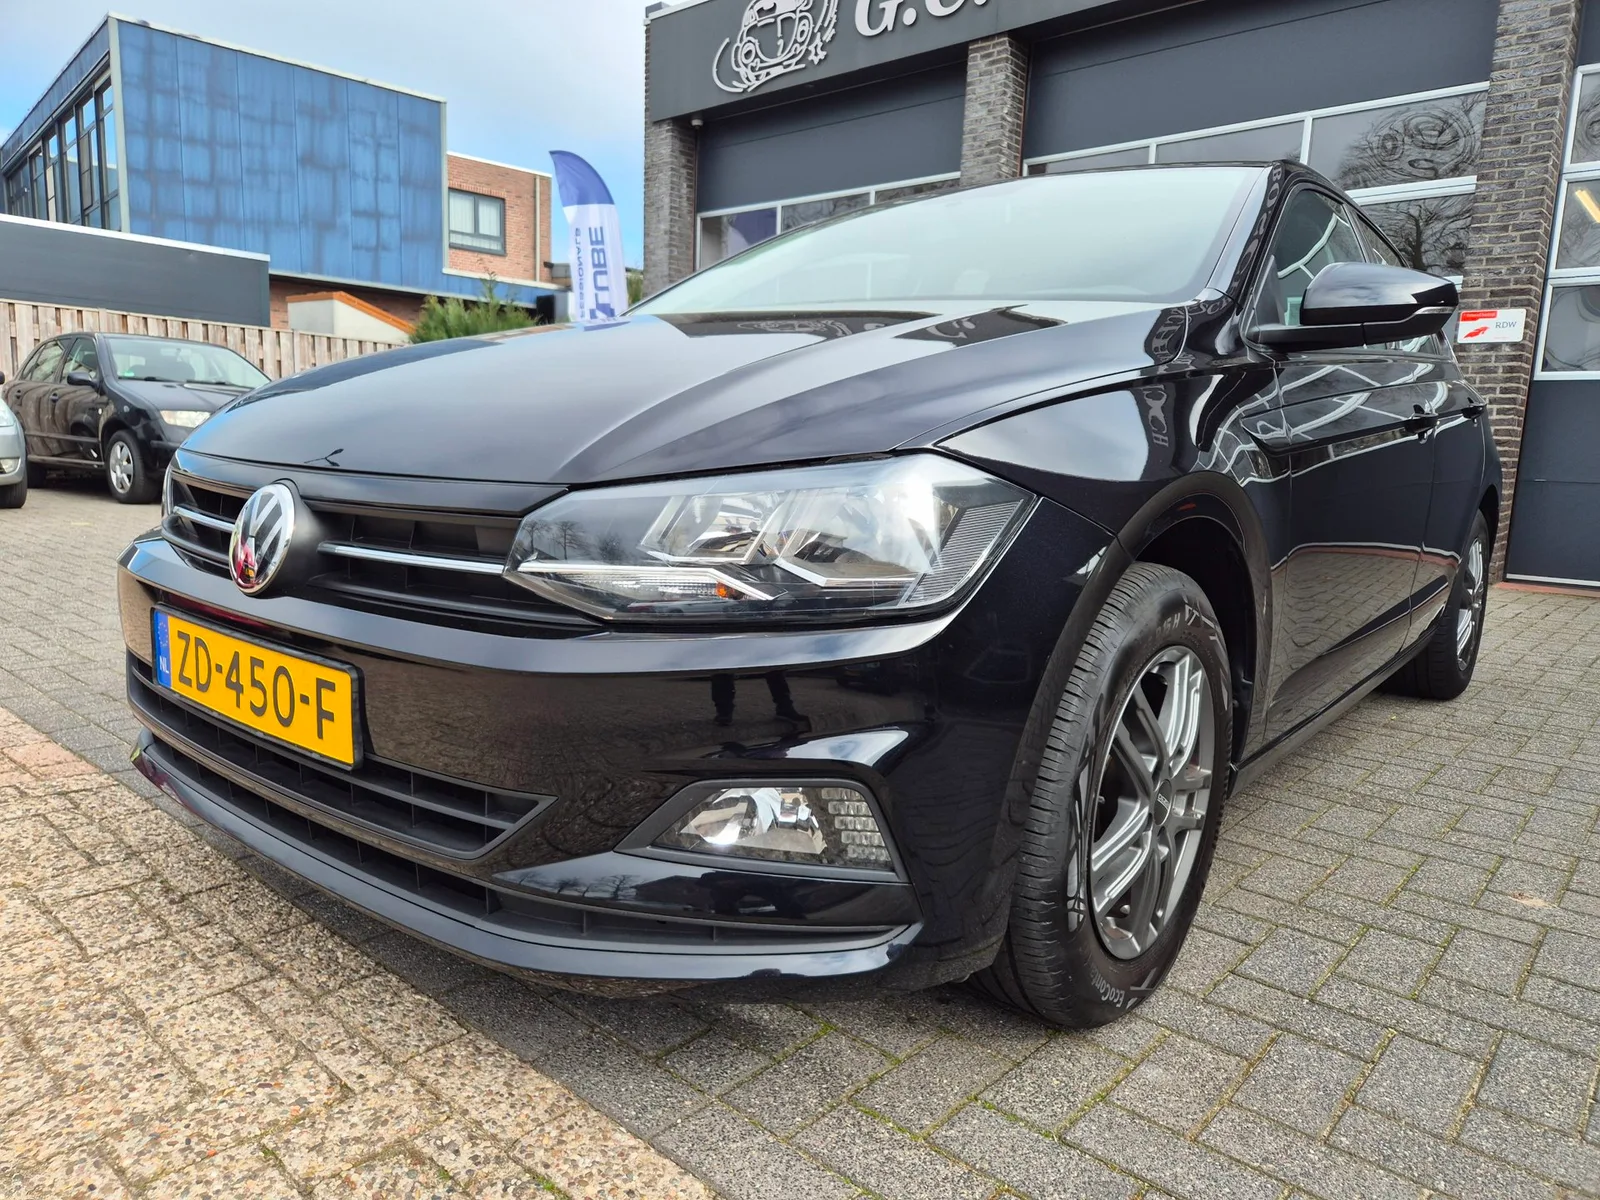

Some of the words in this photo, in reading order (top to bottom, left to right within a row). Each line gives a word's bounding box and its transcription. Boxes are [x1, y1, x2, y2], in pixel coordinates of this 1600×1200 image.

[1495, 321, 1517, 329] RDW
[159, 655, 170, 674] NL
[177, 630, 336, 740] ZD-450-F
